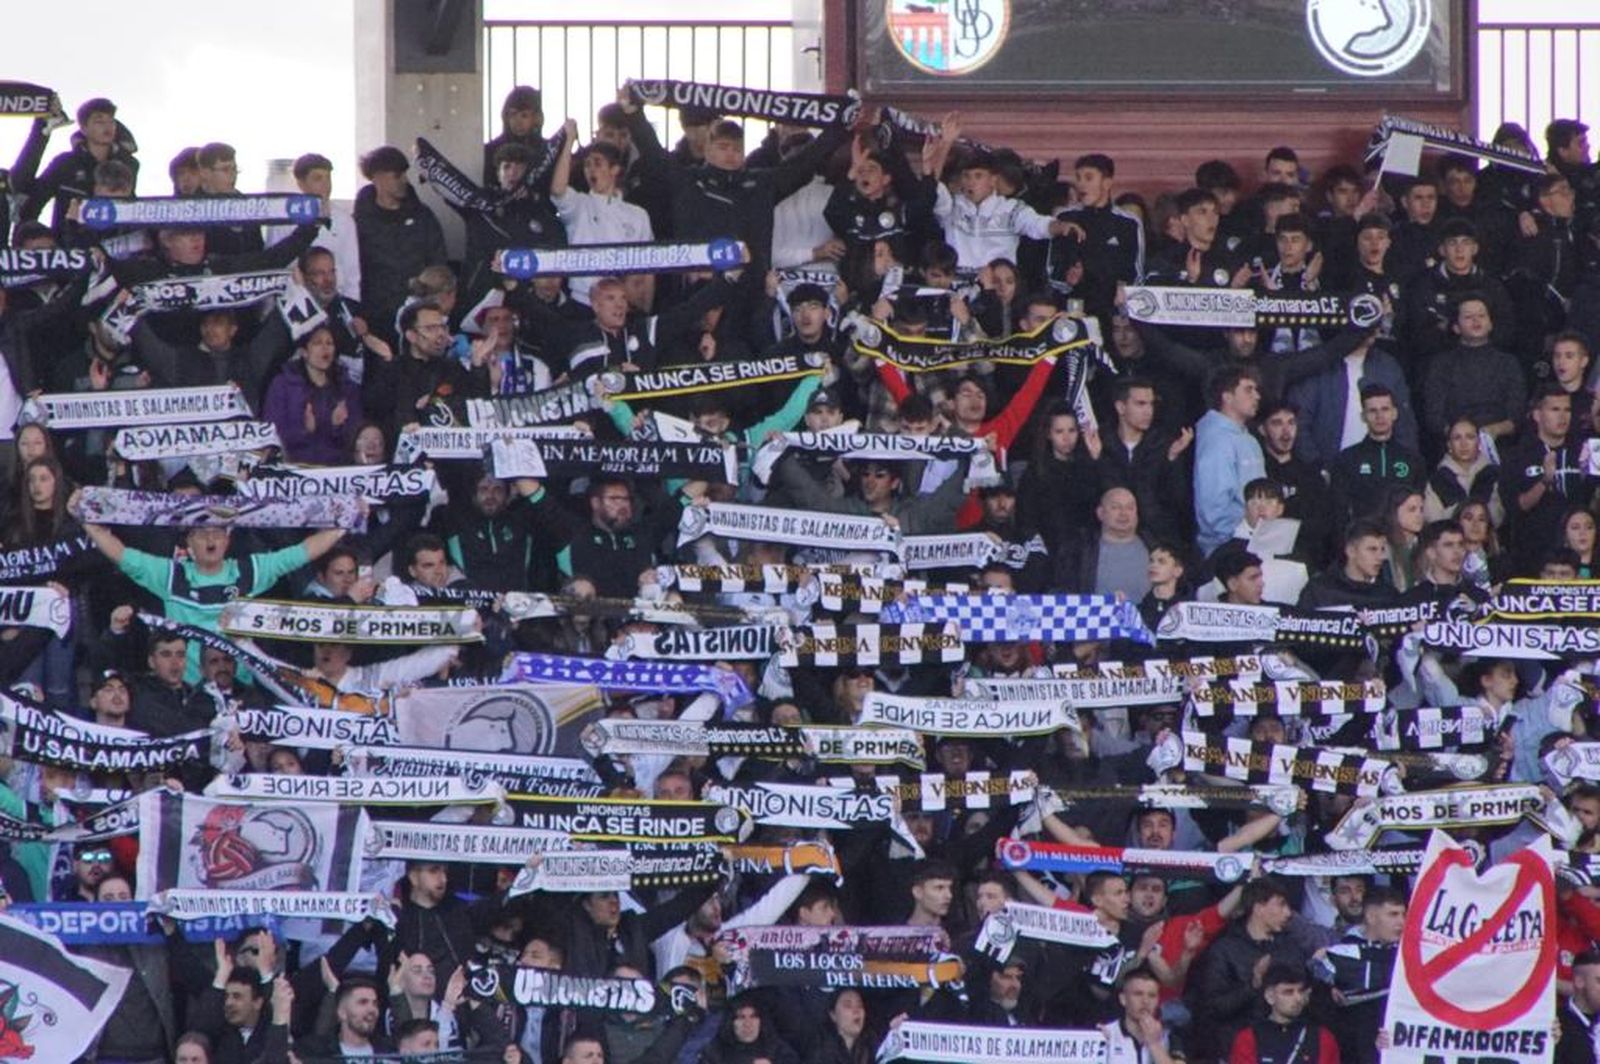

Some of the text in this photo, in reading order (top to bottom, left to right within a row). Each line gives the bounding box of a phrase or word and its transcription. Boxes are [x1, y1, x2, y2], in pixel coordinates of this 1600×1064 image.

[673, 82, 839, 122] UNIONISTAS
[1162, 292, 1232, 312] UNIONISTAS
[1250, 297, 1320, 314] Salamanca
[635, 355, 798, 391] NUNCA SE RINDE
[55, 401, 122, 421] UNIONISTAS
[124, 400, 140, 416] DE
[142, 396, 209, 416] SALAMANCA
[543, 444, 724, 465] IN MEMORIAM VDS
[252, 470, 423, 498] UNIONISTAS
[711, 510, 778, 531] UNIONISTAS
[782, 517, 796, 532] DE
[800, 519, 870, 539] SALAMANCA
[904, 541, 971, 560] SALAMANCA
[1530, 585, 1600, 597] UNIONISTAS
[1559, 595, 1589, 612] SE
[332, 618, 358, 635] DE
[1187, 606, 1256, 627] UNIONISTAS
[1273, 615, 1341, 634] Salamanca
[1424, 624, 1600, 651] UNIONISTAS
[1000, 683, 1068, 700] UNIONISTAS
[1071, 682, 1088, 698] DE
[1090, 678, 1158, 698] SALAMANCA
[612, 722, 683, 742] UNIONISTAS
[700, 727, 767, 743] Salamanca
[819, 739, 843, 753] DE
[576, 804, 651, 817] UNIONISTAS
[1434, 803, 1459, 819] DE
[606, 816, 636, 835] SE
[639, 816, 706, 836] RINDE
[393, 832, 459, 851] UNIONISTAS
[463, 834, 478, 851] DE
[481, 836, 548, 854] SALAMANCA
[545, 855, 609, 876] UNIONISTAS
[625, 854, 692, 874] Salamanca
[1051, 851, 1124, 866] MEMORIAL
[180, 895, 249, 914] UNIONISTAS
[252, 897, 268, 913] DE
[270, 896, 341, 914] SALAMANCA
[1459, 902, 1544, 944] GETA
[773, 953, 864, 970] LOS LOCOS
[513, 967, 657, 1014] UNIONISTAS
[826, 972, 919, 989] DEL REINA
[911, 1030, 1098, 1058] UNIONISTAS DE SALAMANCA CF
[1393, 1021, 1549, 1056] DIFAMADORES
